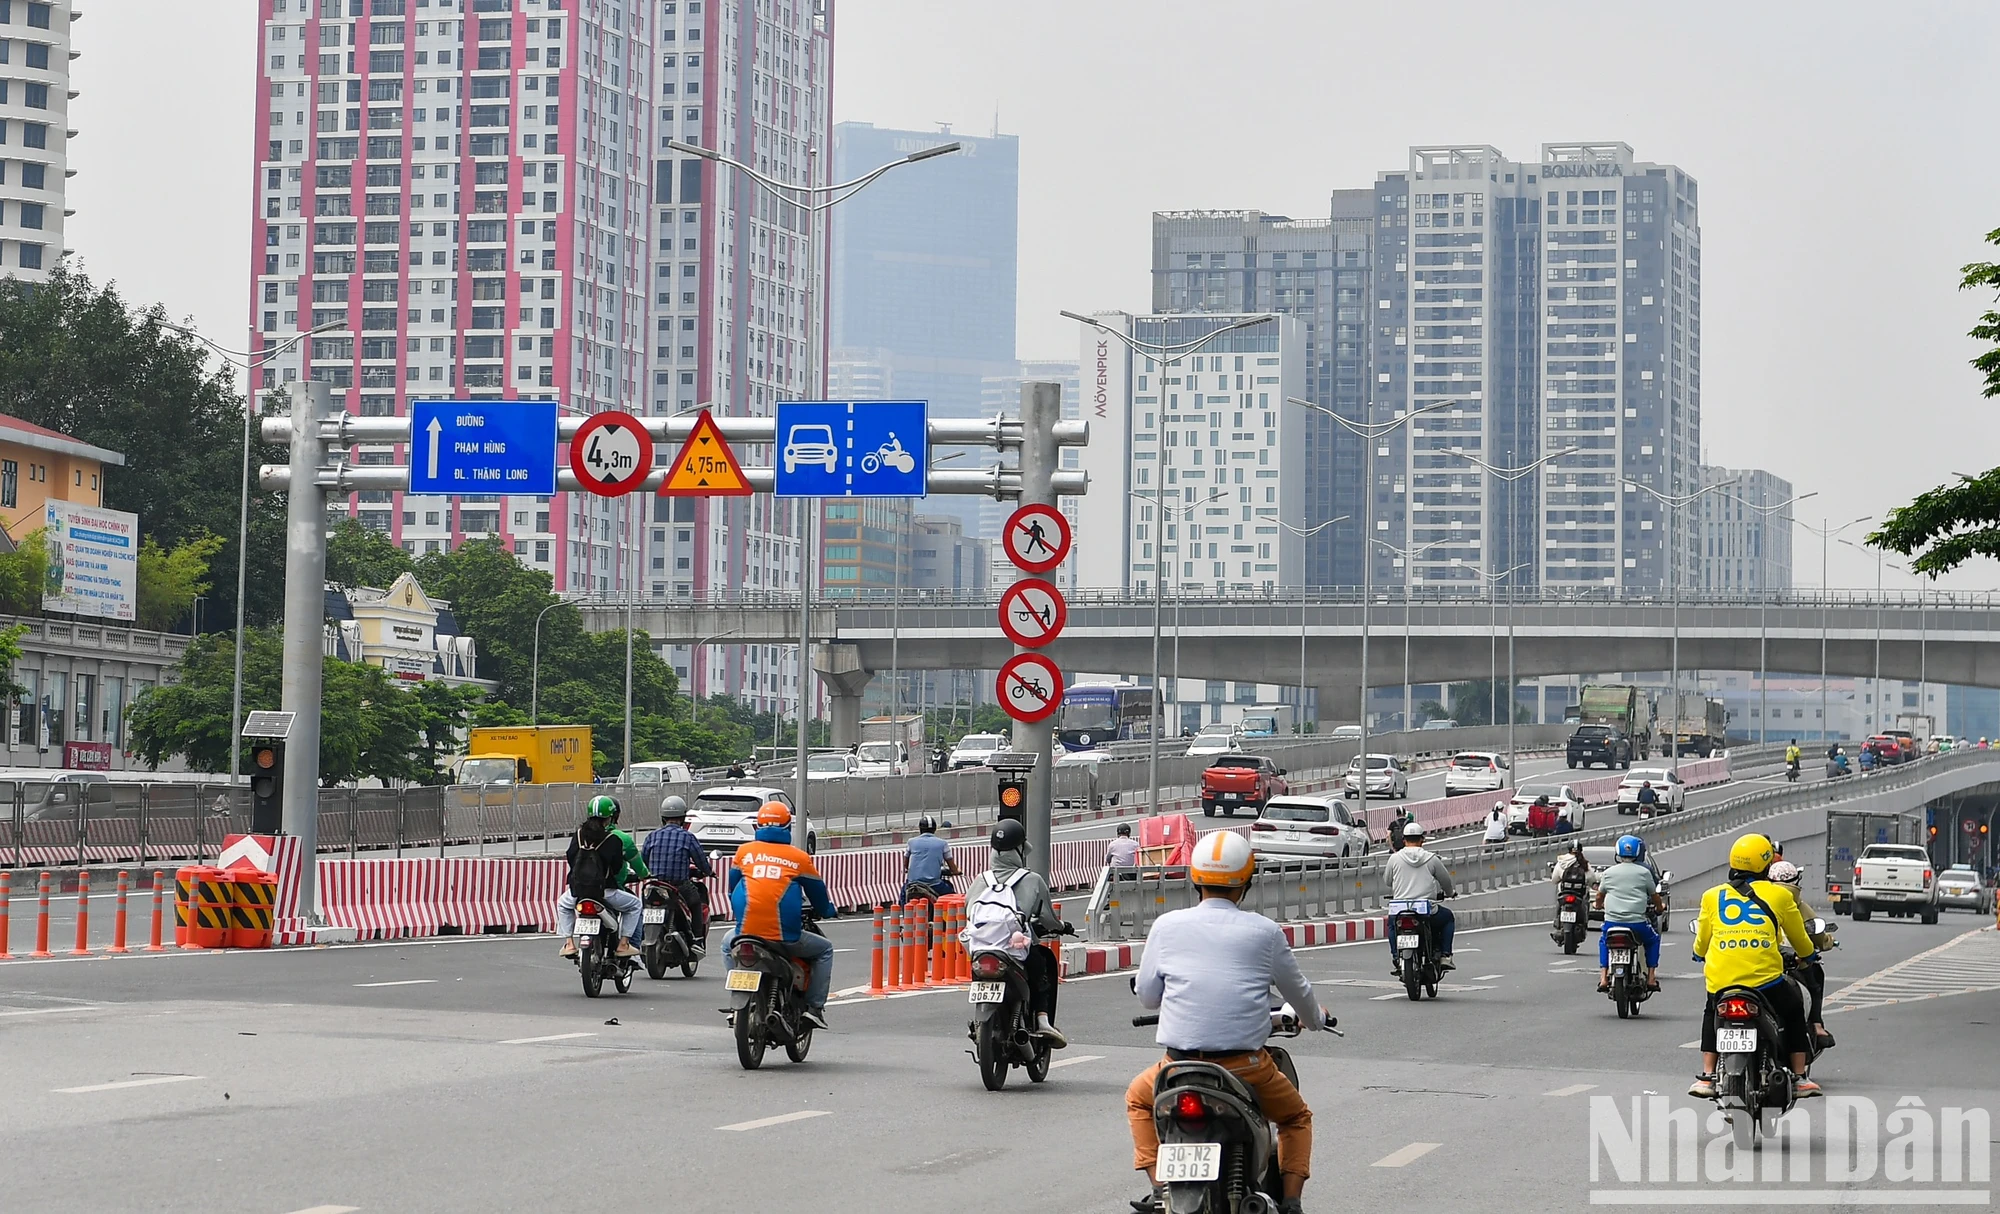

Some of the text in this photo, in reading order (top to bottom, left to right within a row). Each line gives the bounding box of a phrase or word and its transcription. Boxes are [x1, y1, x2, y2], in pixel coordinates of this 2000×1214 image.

[961, 141, 977, 157] 72
[1541, 163, 1623, 178] BONANZA
[1094, 340, 1107, 418] MÖVENPICK
[456, 413, 484, 427] ĐƯỜNG
[455, 440, 506, 455] PHẠM HÙNG
[587, 436, 632, 470] 4,3m
[686, 456, 727, 475] 4,75m
[454, 468, 469, 480] ĐL.
[506, 469, 528, 480] LONG
[755, 853, 799, 869] Ahamove
[1719, 889, 1767, 926] be
[977, 983, 1000, 991] 15-AN
[1723, 1030, 1750, 1040] 29-AL
[1720, 1041, 1754, 1051] 000.53
[1168, 1147, 1211, 1161] 30-N2
[1166, 1163, 1210, 1178] 9303
